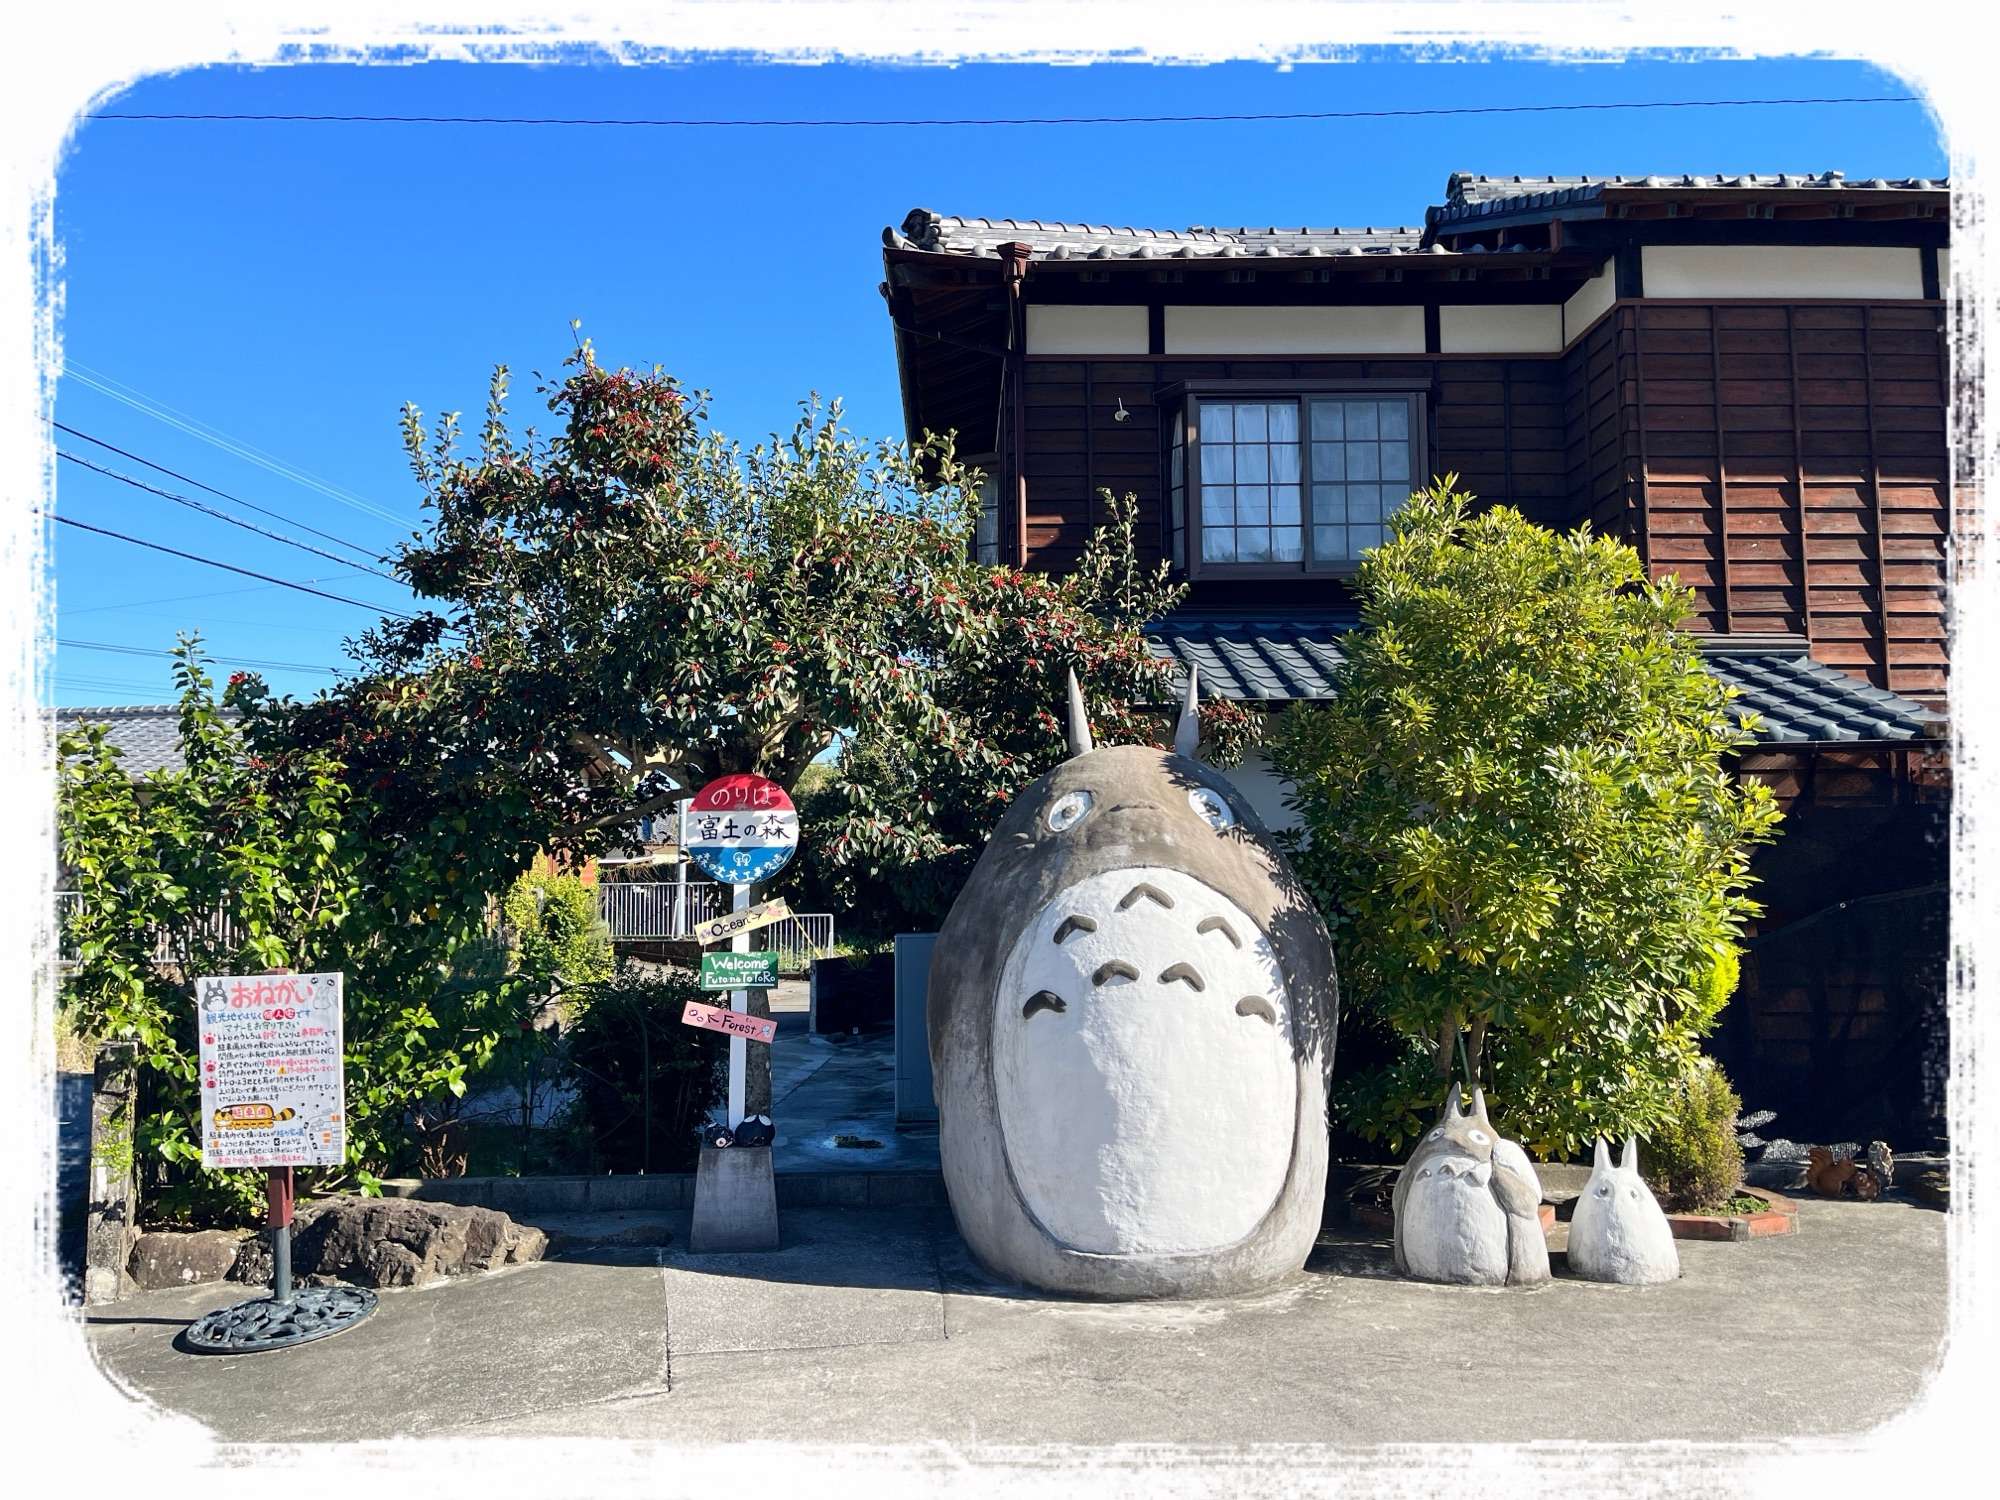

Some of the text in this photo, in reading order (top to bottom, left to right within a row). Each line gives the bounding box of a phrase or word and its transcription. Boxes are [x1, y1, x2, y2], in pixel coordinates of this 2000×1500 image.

[711, 786, 777, 805] のりば
[710, 916, 751, 936] Ocean
[710, 956, 770, 970] Welcome
[230, 978, 313, 1008] おねがい
[721, 1014, 757, 1035] Forest
